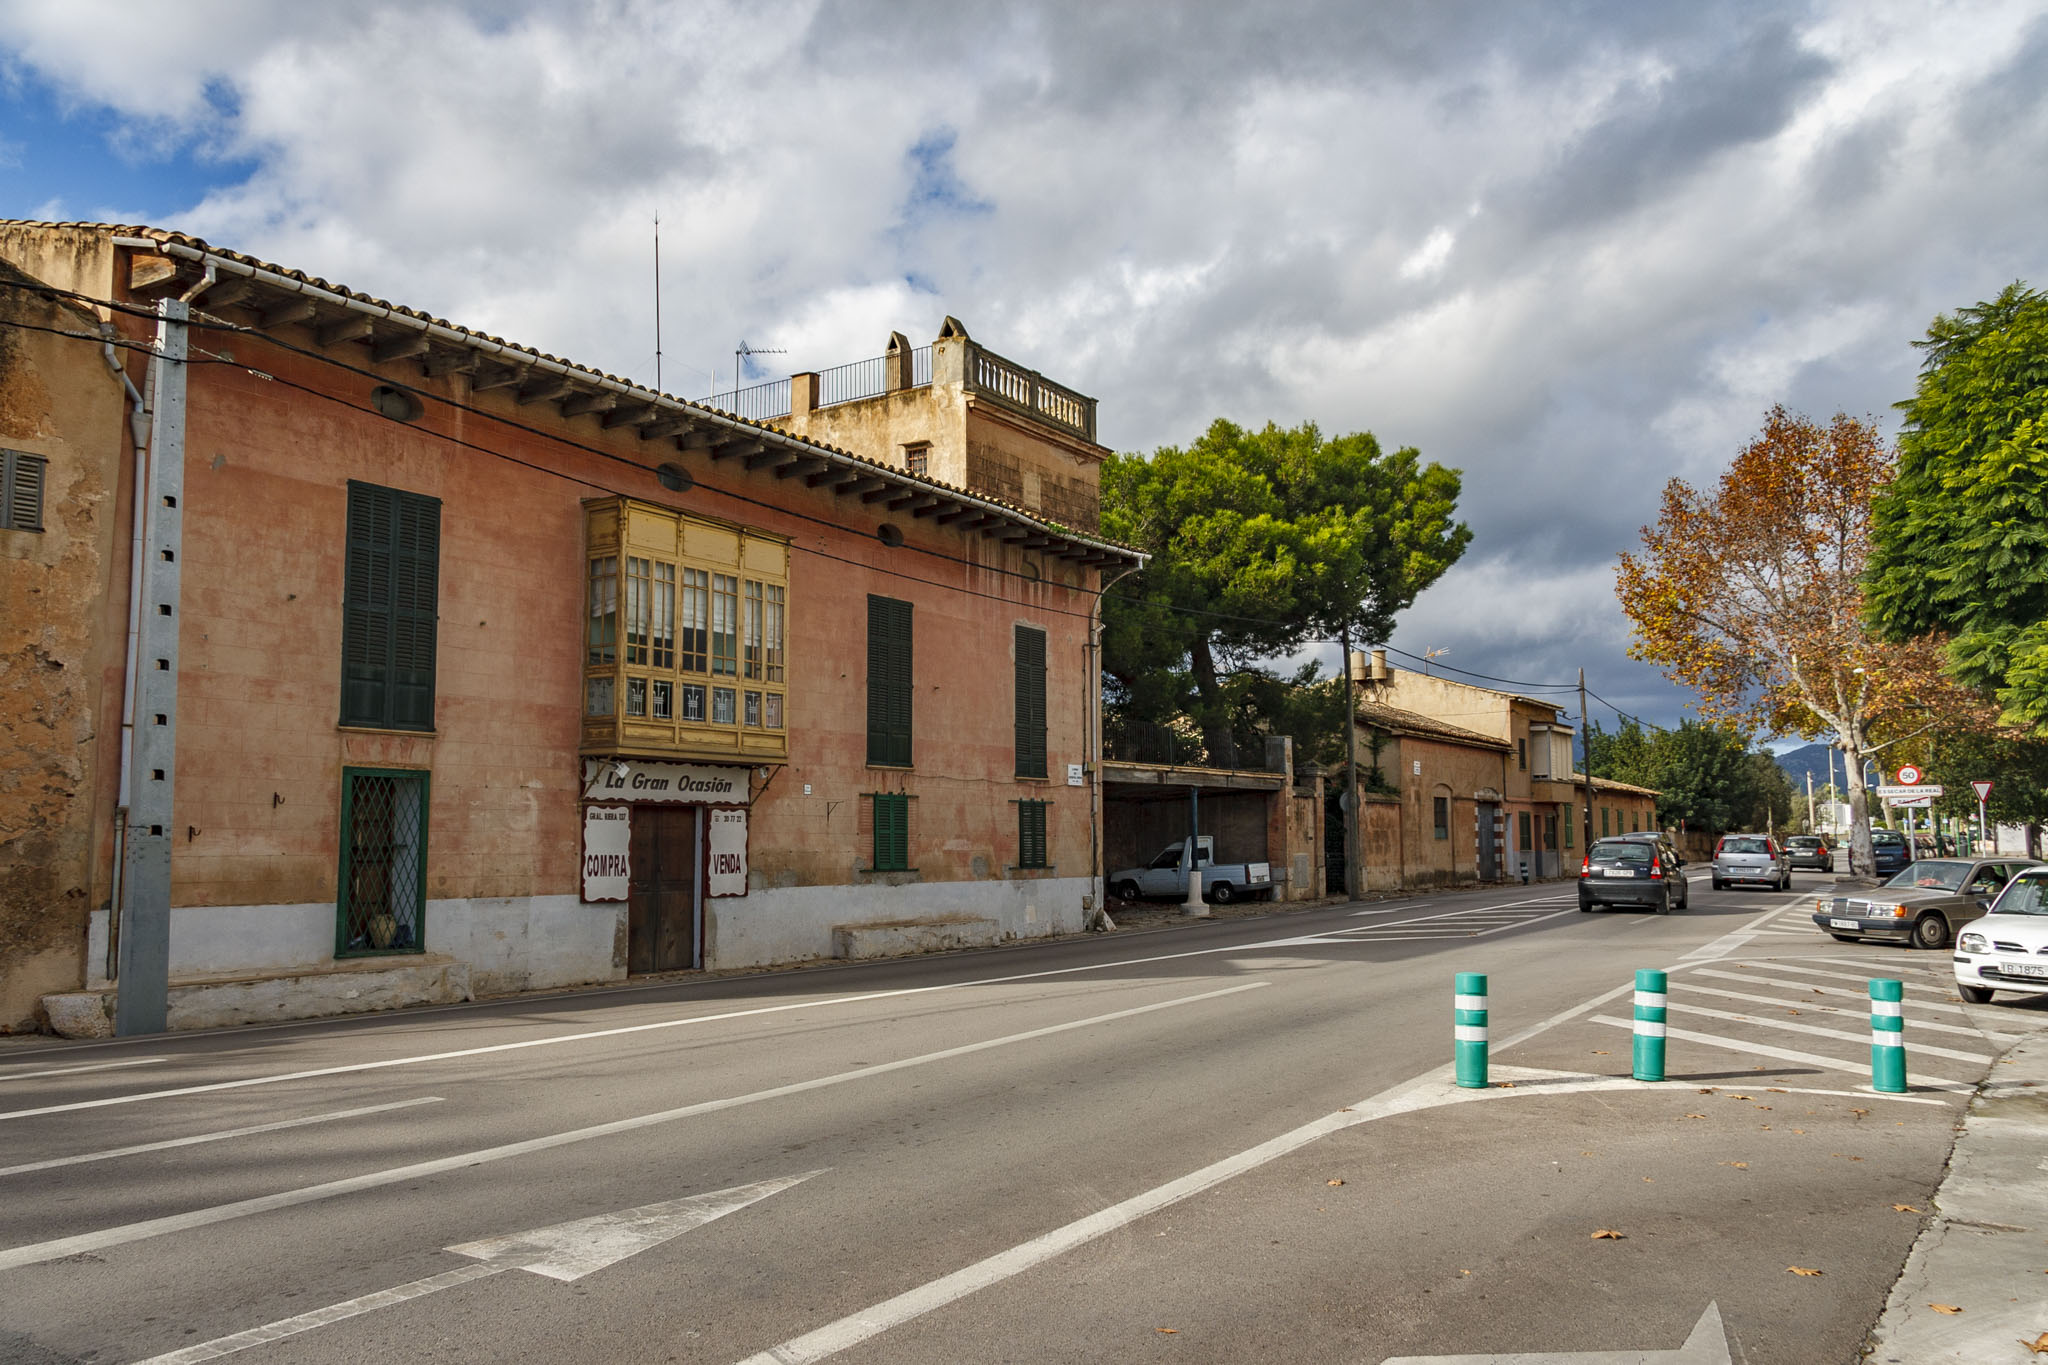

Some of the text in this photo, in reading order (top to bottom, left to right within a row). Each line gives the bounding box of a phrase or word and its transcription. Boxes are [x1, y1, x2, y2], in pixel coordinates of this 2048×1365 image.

[604, 771, 733, 793] La Gran Ocasión
[589, 812, 603, 821] GRAL.
[587, 854, 628, 877] COMPRA
[713, 853, 742, 875] VENDA
